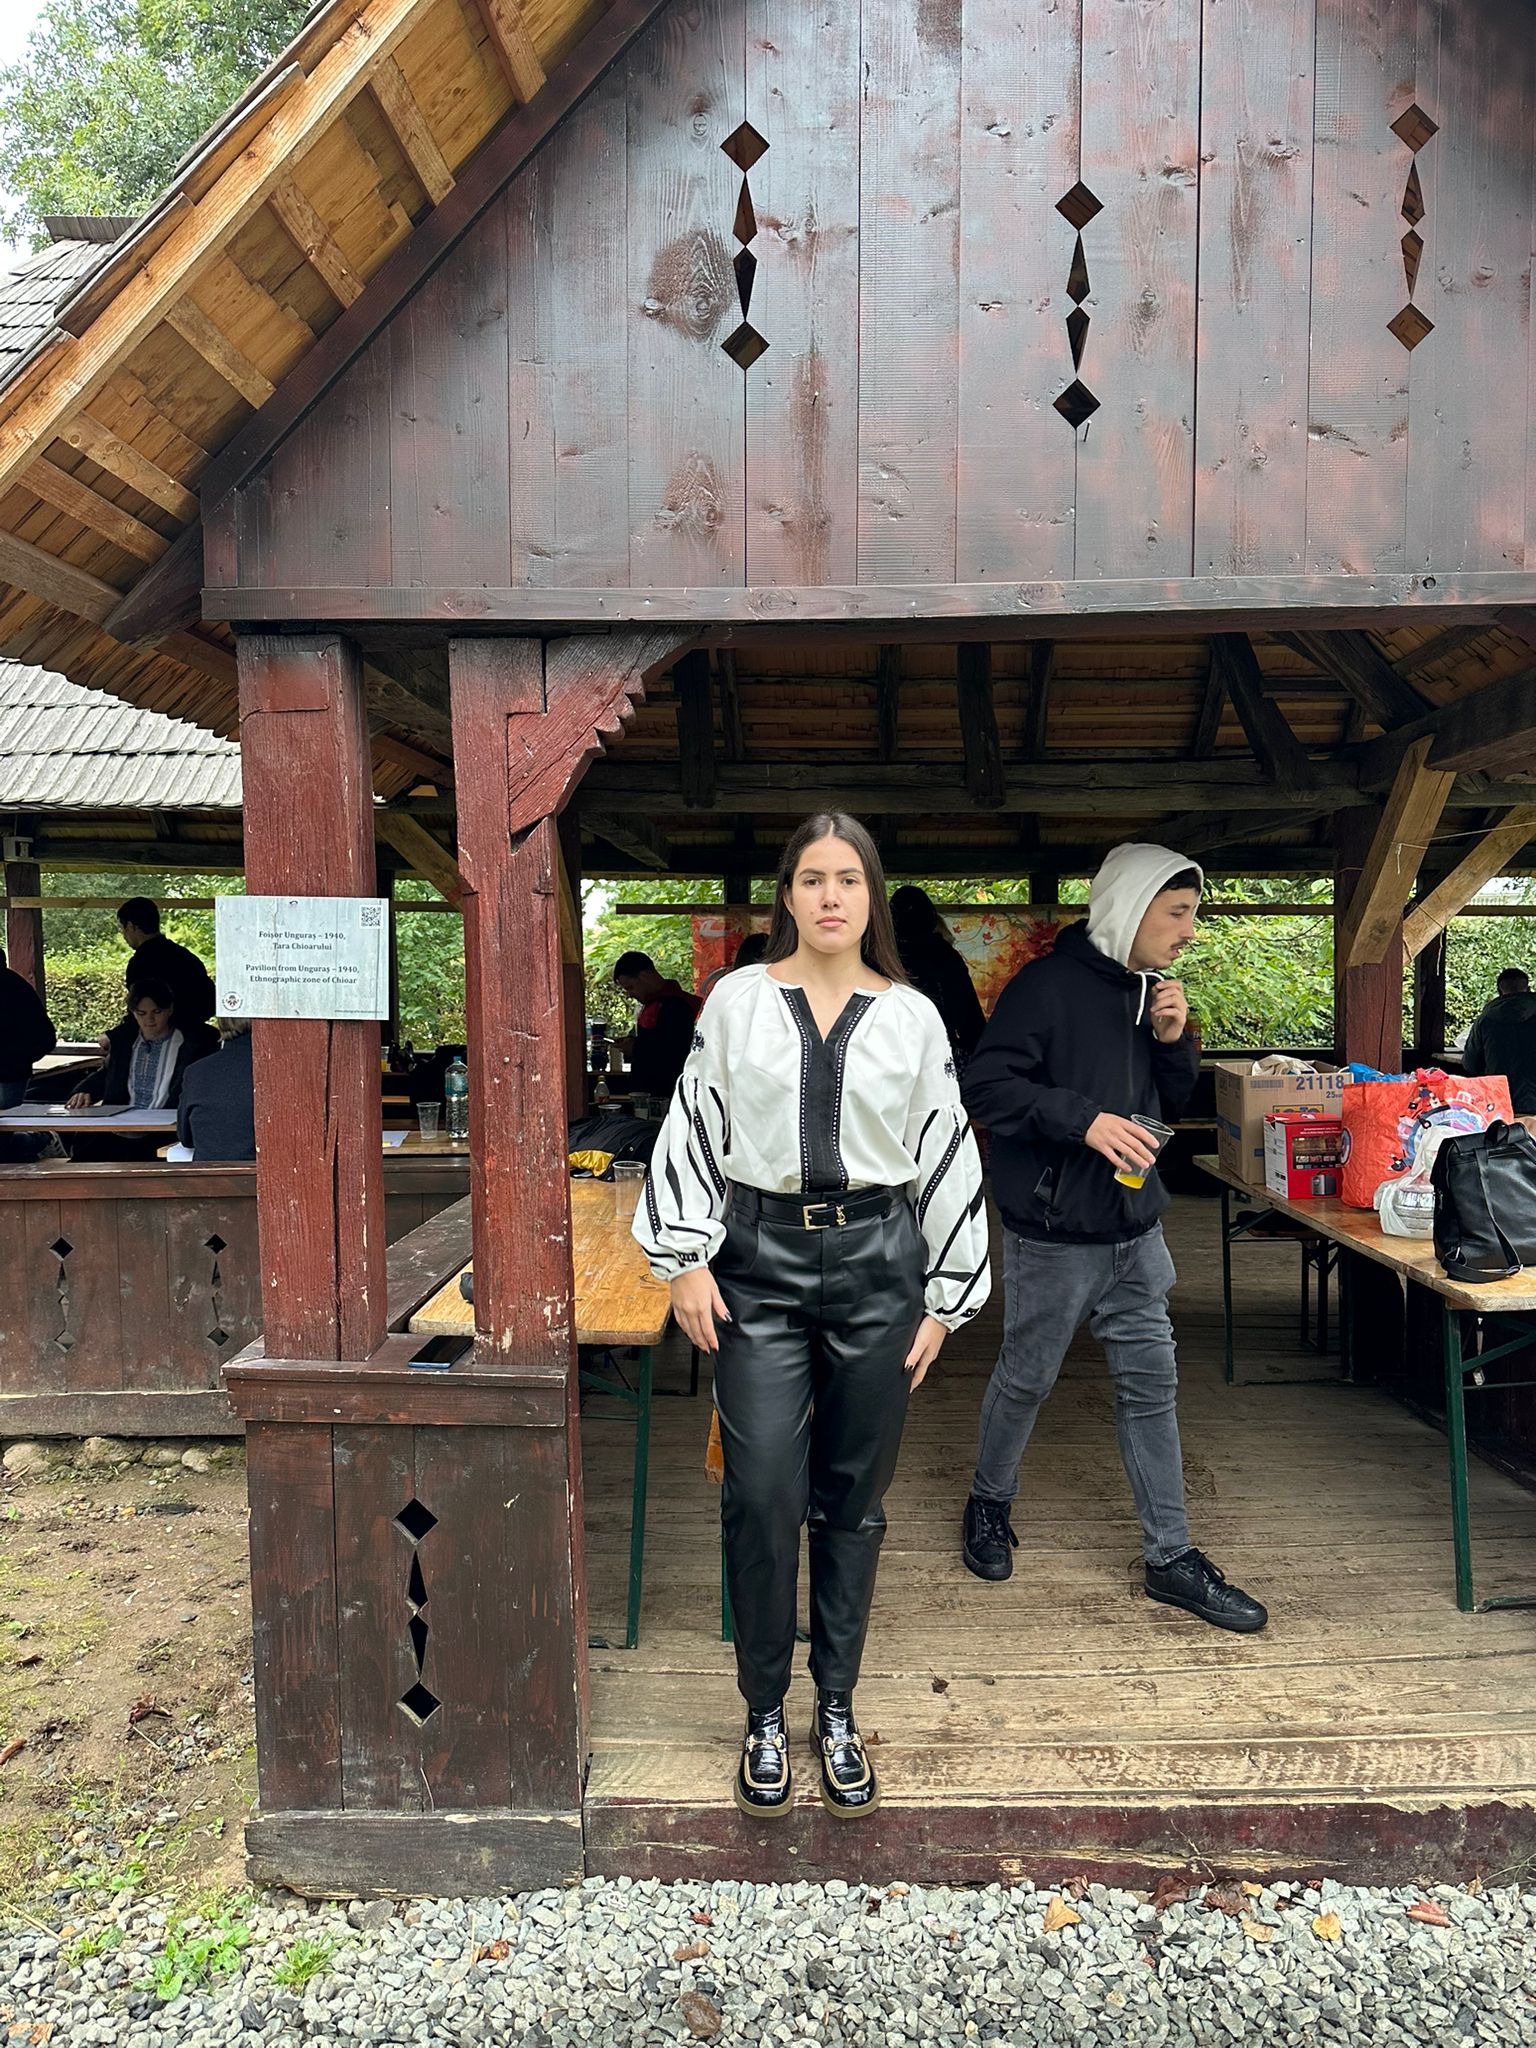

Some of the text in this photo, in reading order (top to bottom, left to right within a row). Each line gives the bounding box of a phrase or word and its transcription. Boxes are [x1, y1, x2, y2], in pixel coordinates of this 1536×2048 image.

[324, 932, 346, 940] 1940,
[245, 964, 277, 972] Pavilion
[278, 964, 297, 972] from
[338, 966, 360, 974] 1940,
[250, 975, 302, 984] Ethnographic
[322, 975, 330, 983] of
[331, 976, 357, 984] Chioar
[1296, 1075, 1345, 1090] 21118
